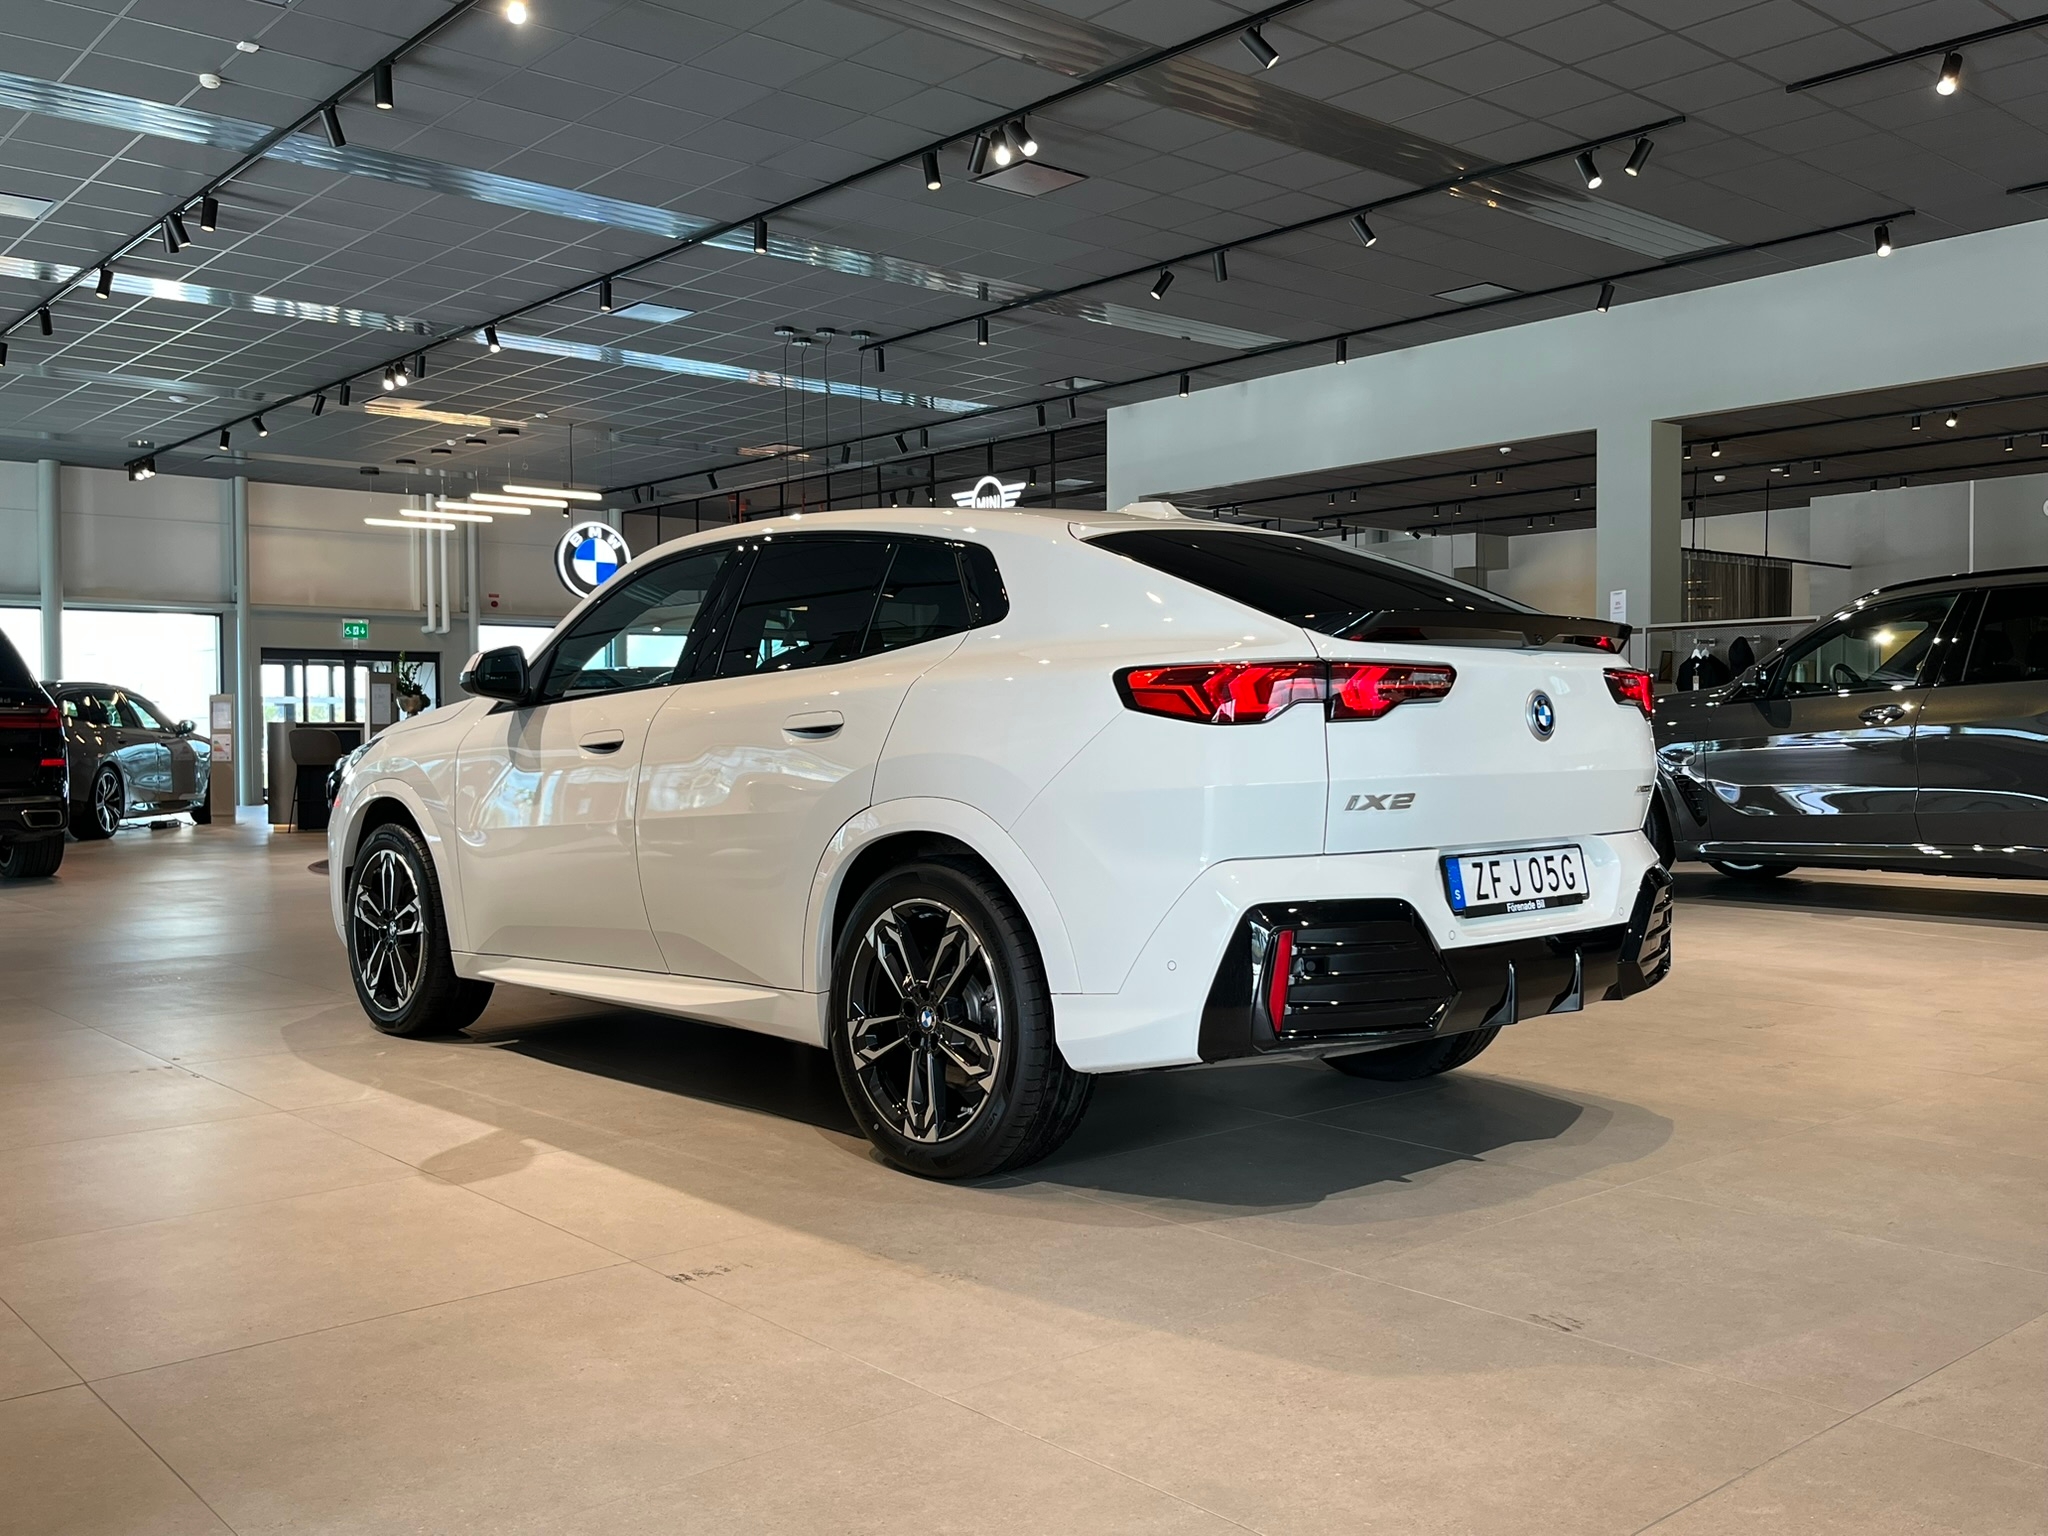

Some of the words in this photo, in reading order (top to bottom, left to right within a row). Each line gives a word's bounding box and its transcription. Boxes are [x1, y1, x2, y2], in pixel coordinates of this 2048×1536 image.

[976, 494, 1000, 508] MINI
[569, 526, 622, 550] BMW
[1471, 859, 1522, 901] ZFJ
[1528, 854, 1576, 894] 05G
[1454, 889, 1462, 900] S
[1506, 901, 1536, 913] Förenade
